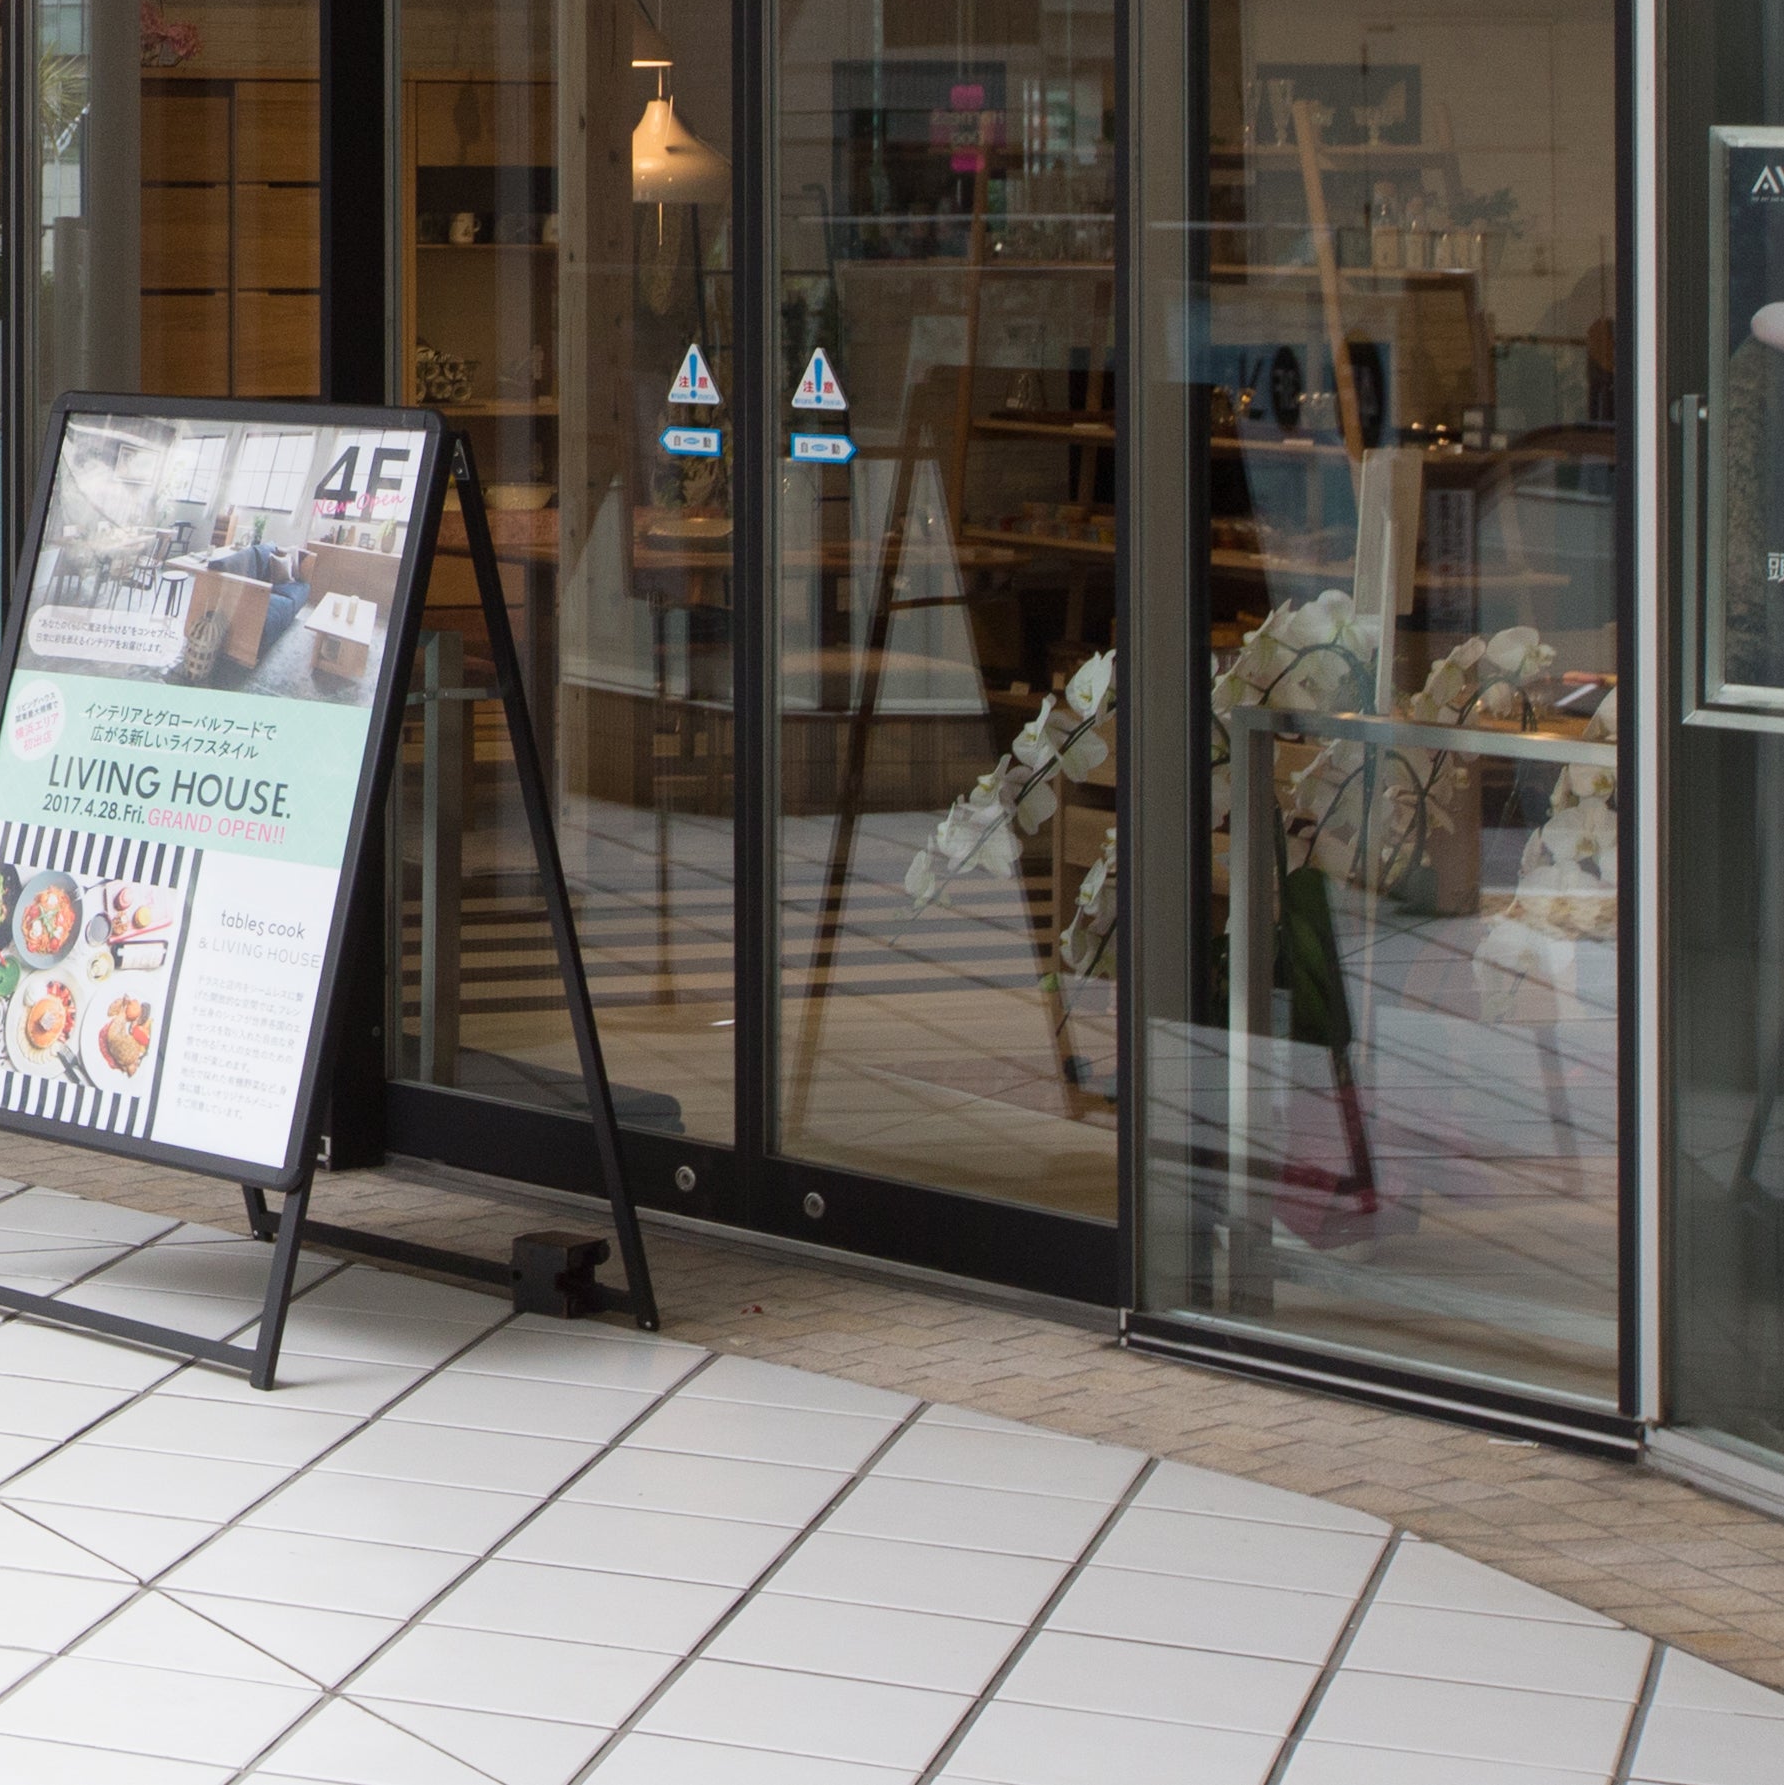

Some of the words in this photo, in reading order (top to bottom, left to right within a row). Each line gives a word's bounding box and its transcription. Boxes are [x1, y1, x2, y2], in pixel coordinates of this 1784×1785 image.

[314, 446, 411, 522] 4F
[356, 492, 407, 513] Open
[84, 703, 277, 741] インテリアとグローバルフードで
[90, 724, 260, 760] 広がる新しいライフスタイル
[48, 754, 161, 799] LIVING
[171, 769, 291, 819] HOUSE.
[147, 807, 212, 833] GRAND
[217, 817, 286, 845] OPEN!!
[221, 910, 265, 936] tables
[268, 922, 306, 939] cook
[198, 937, 208, 949] &
[212, 937, 264, 959] LIVING
[267, 947, 322, 969] HOUSE
